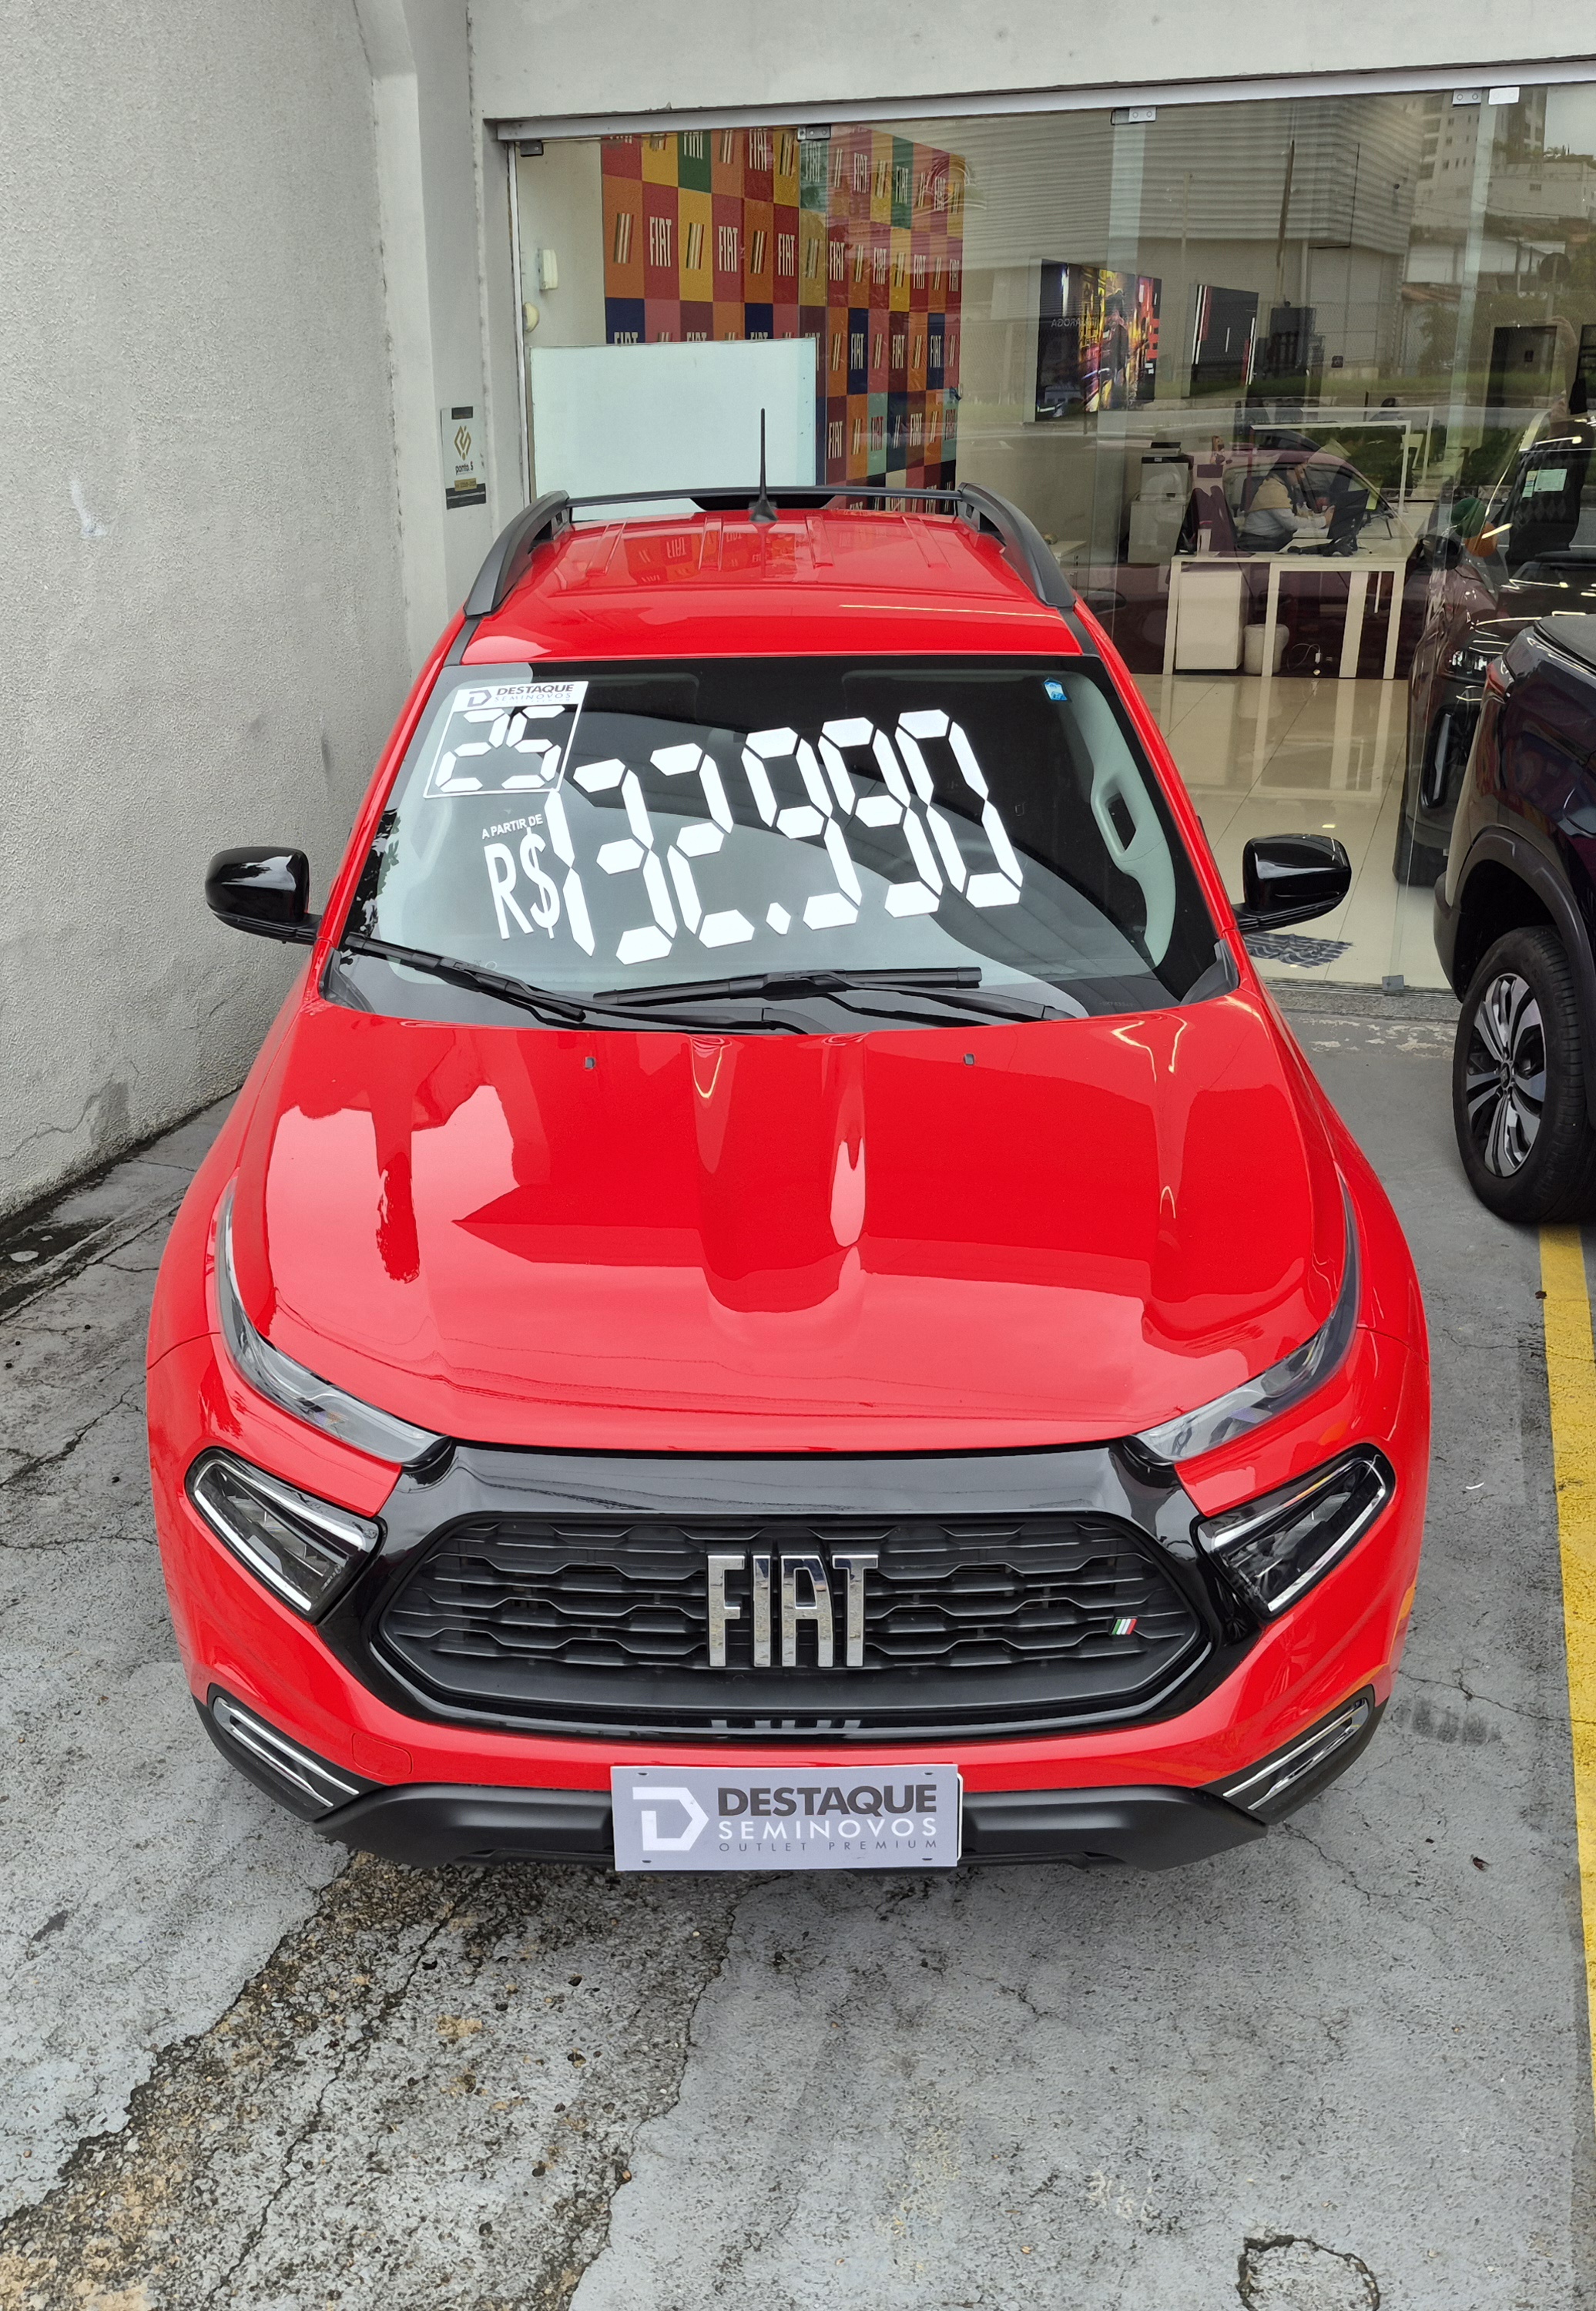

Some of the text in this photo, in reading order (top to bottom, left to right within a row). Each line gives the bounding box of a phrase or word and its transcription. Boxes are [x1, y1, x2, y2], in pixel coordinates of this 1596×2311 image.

[853, 152, 868, 193] FIAT
[649, 216, 672, 267] FIAT
[718, 225, 739, 273] FIAT
[777, 233, 796, 277] FIAT
[829, 240, 846, 282] FIAT
[913, 254, 927, 290] FIAT
[850, 332, 865, 371] FIAT
[891, 334, 906, 370] FIAT
[930, 334, 942, 368] FIAT
[827, 421, 843, 460] FIAT
[909, 412, 923, 448] FIAT
[495, 693, 571, 702] SEMINOVOS
[497, 684, 574, 695] DESTAQUE
[435, 705, 565, 792] 25
[482, 813, 544, 840] A PARTIR DE
[484, 827, 561, 940] R$
[707, 1555, 879, 1668] FIAT
[717, 1784, 937, 1817] DESTAQUE
[718, 1817, 937, 1840] SEMINOVOS
[719, 1840, 937, 1852] OUTLET PREMIUM
